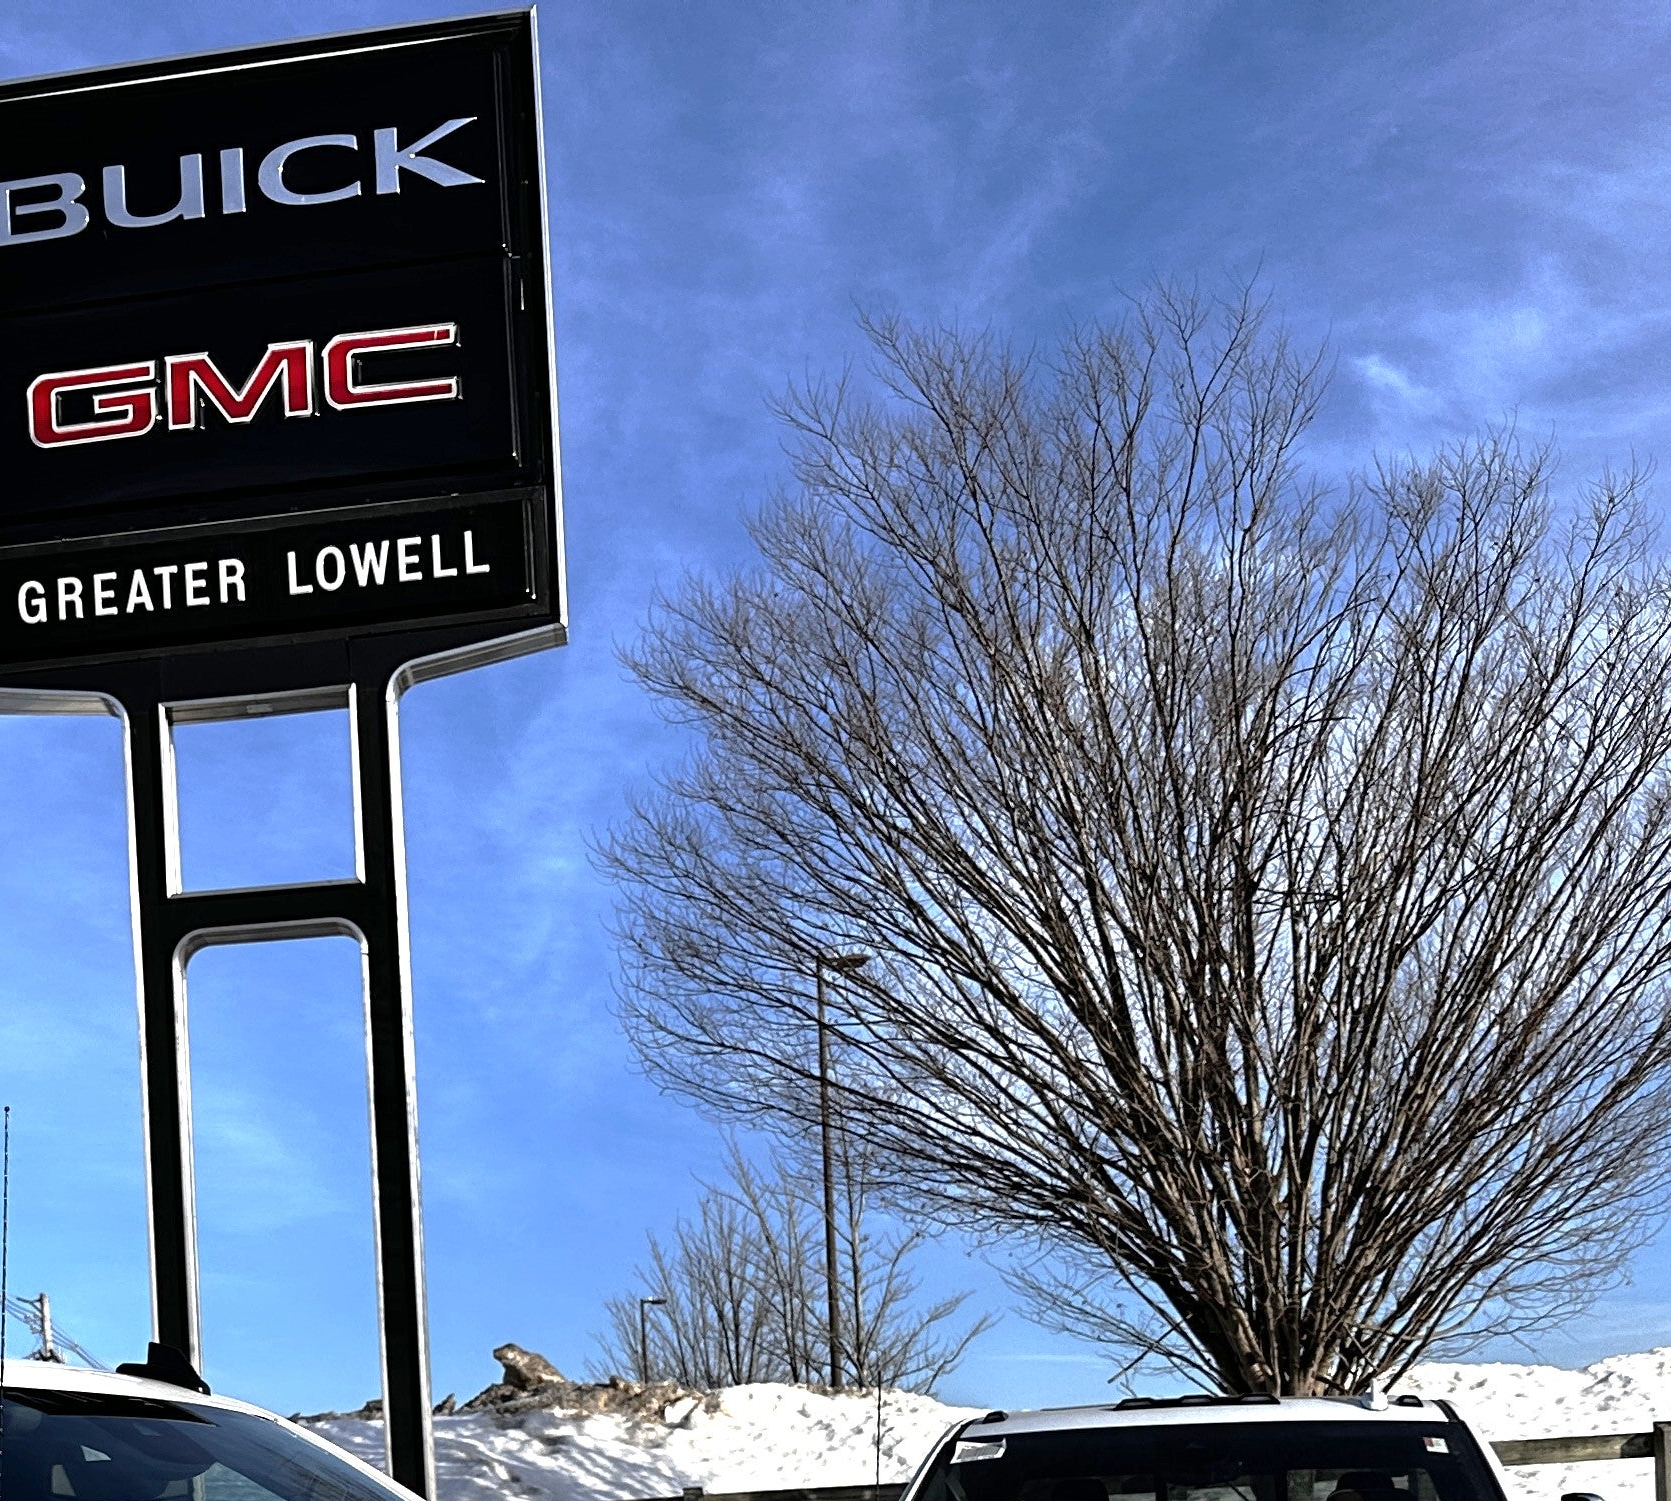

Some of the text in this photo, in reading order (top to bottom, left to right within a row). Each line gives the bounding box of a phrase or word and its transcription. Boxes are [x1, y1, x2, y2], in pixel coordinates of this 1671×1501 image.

[26, 321, 460, 449] GMC
[17, 529, 490, 625] GREATER LOWELL
